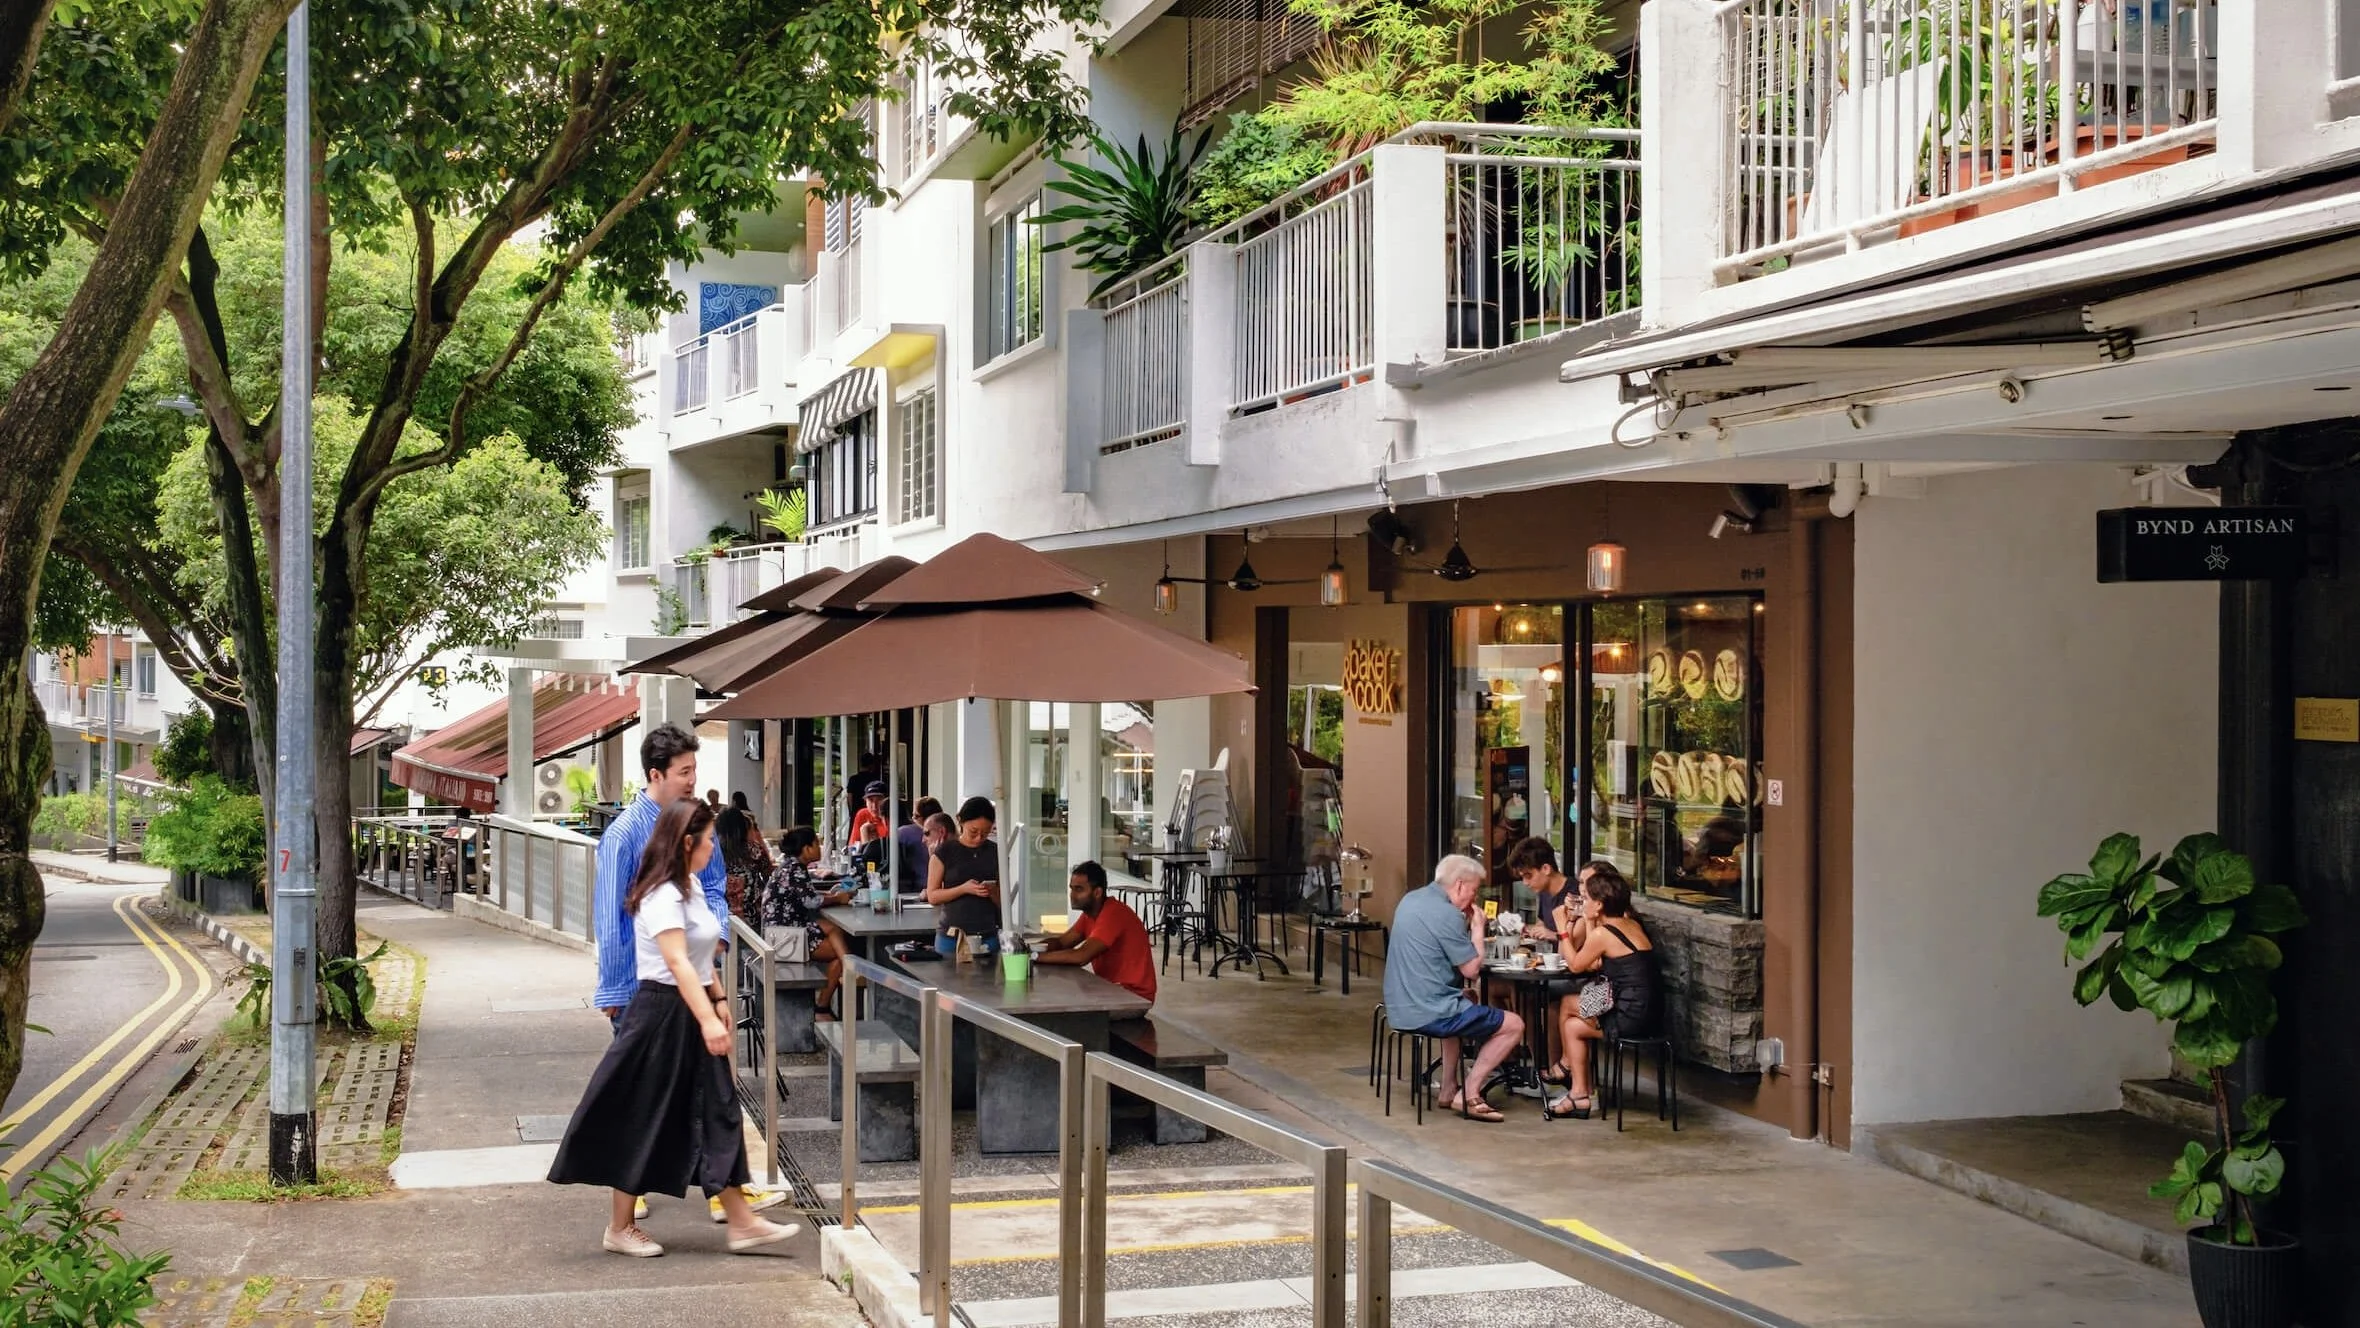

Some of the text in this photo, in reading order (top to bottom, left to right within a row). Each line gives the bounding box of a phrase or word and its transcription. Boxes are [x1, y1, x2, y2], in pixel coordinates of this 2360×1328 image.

[2136, 518, 2295, 535] BYND ARTISAN
[1348, 638, 1392, 681] baker
[1355, 680, 1394, 715] cook
[279, 848, 291, 873] 7
